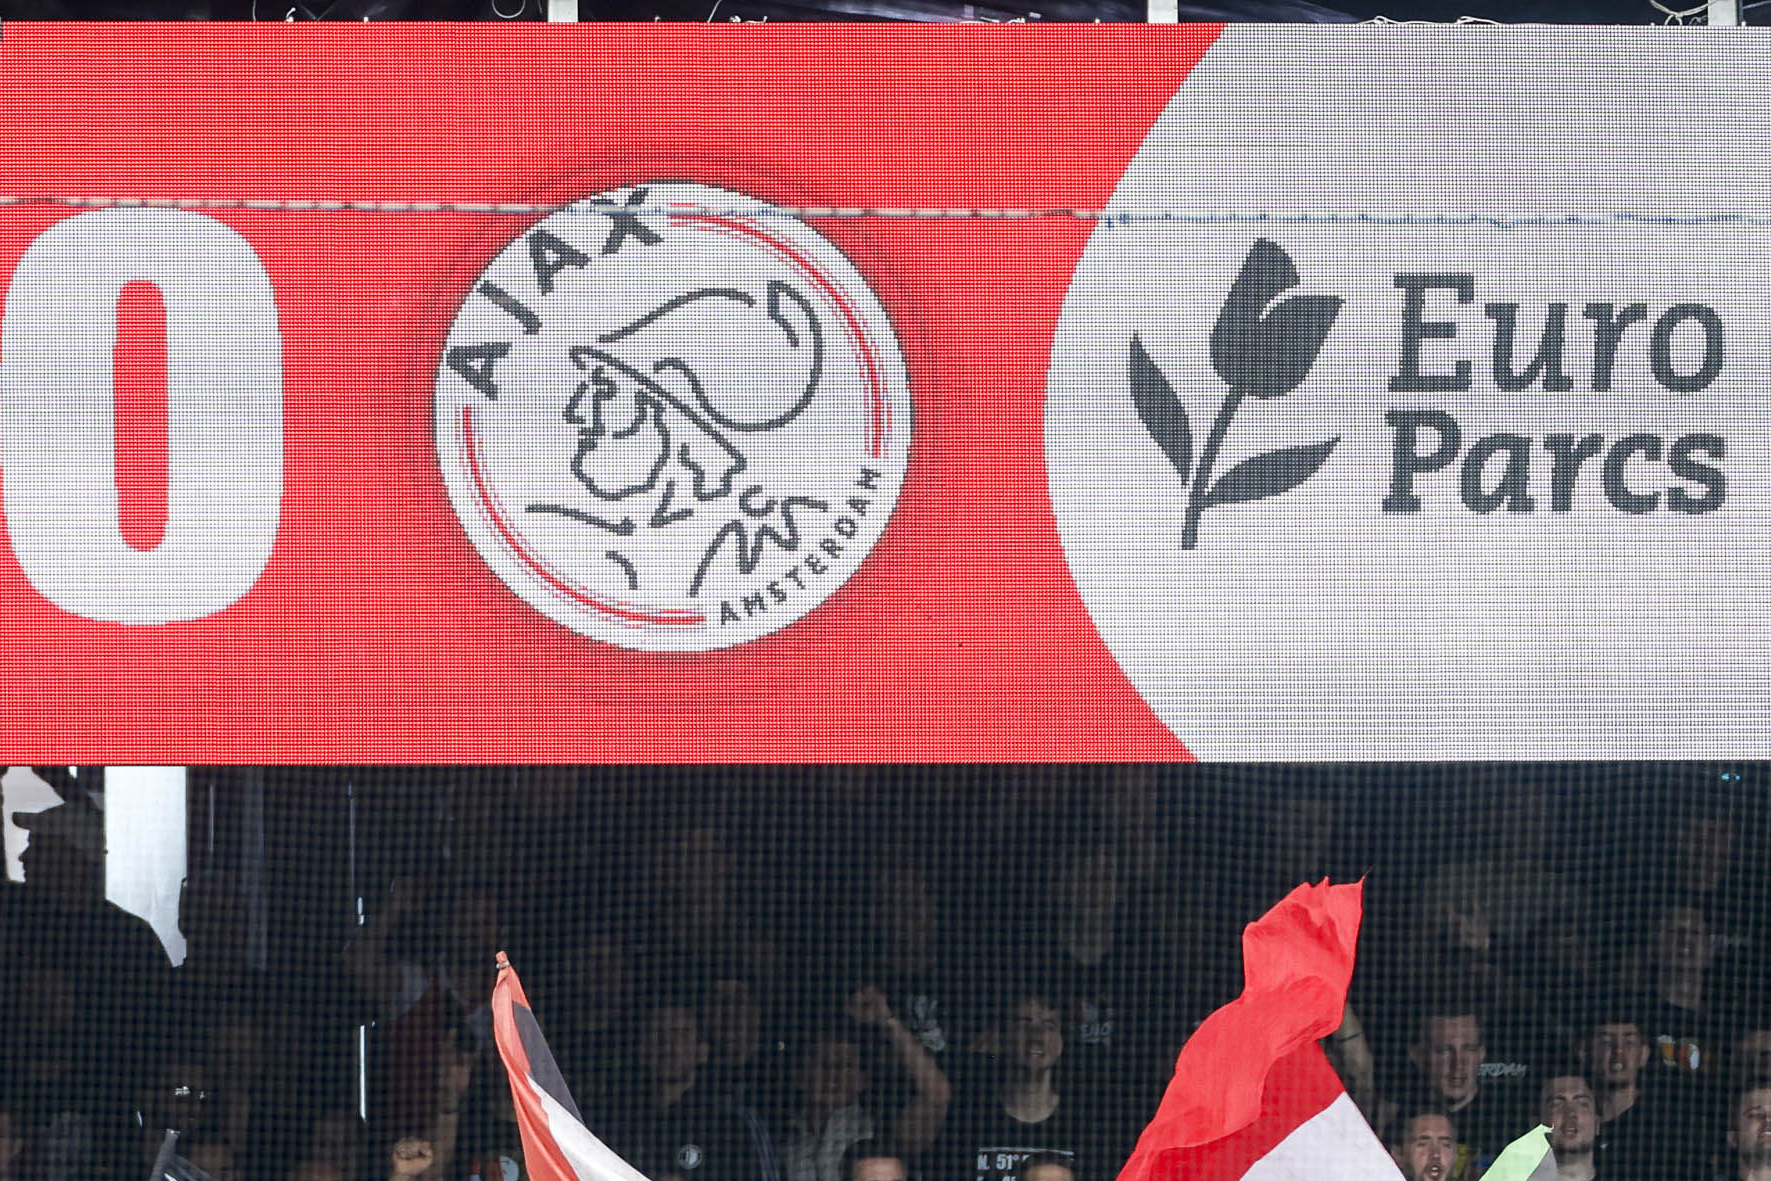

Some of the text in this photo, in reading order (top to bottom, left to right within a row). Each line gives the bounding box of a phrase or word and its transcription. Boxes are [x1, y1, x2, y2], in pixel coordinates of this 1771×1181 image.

[444, 188, 666, 401] AJAX
[1387, 272, 1728, 394] Euro
[1379, 408, 1729, 516] Parcs
[716, 467, 883, 627] AMSTERDAM
